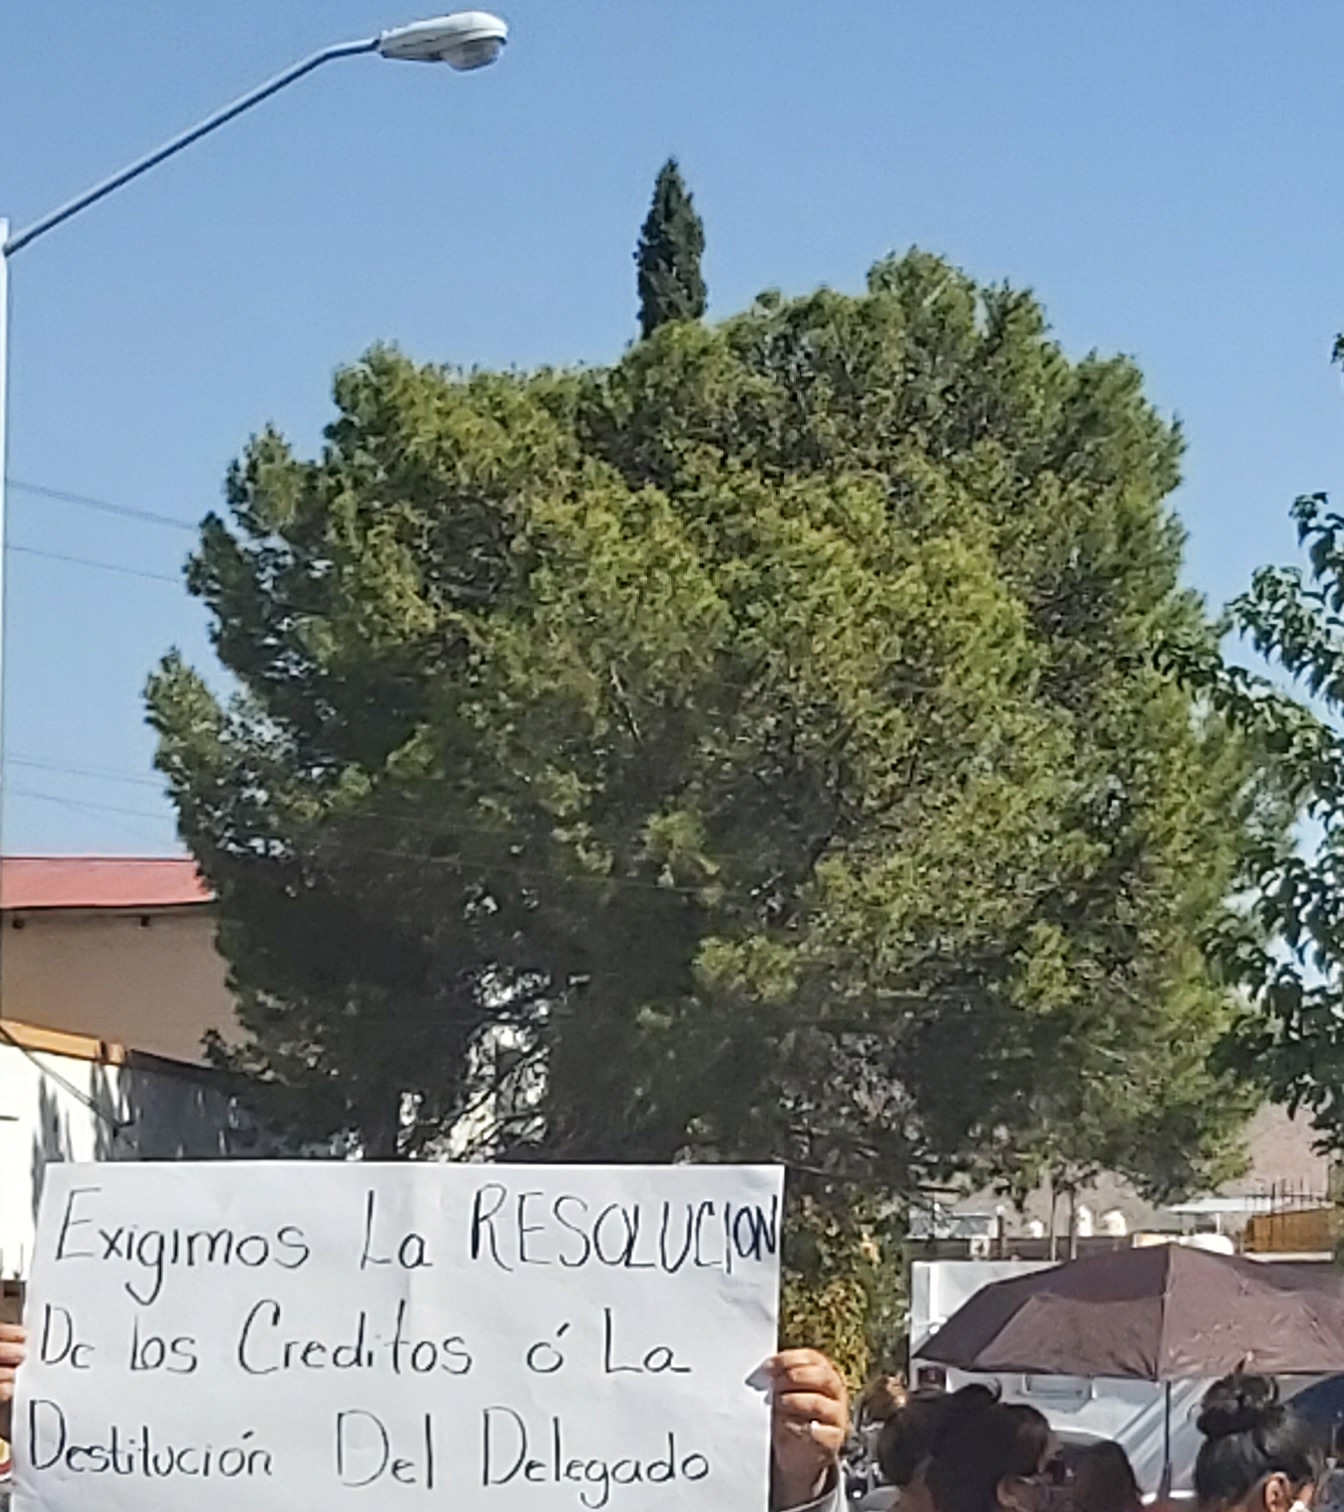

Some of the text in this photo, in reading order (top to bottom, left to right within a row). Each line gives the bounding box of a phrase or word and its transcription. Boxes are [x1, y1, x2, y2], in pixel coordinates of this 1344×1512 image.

[55, 1183, 780, 1306] Exigimos La RESOLUCION
[238, 1299, 474, 1378] Creditos
[526, 1323, 568, 1373] ó
[604, 1307, 692, 1374] La
[336, 1409, 434, 1489] Del
[482, 1406, 709, 1509] Delegado
